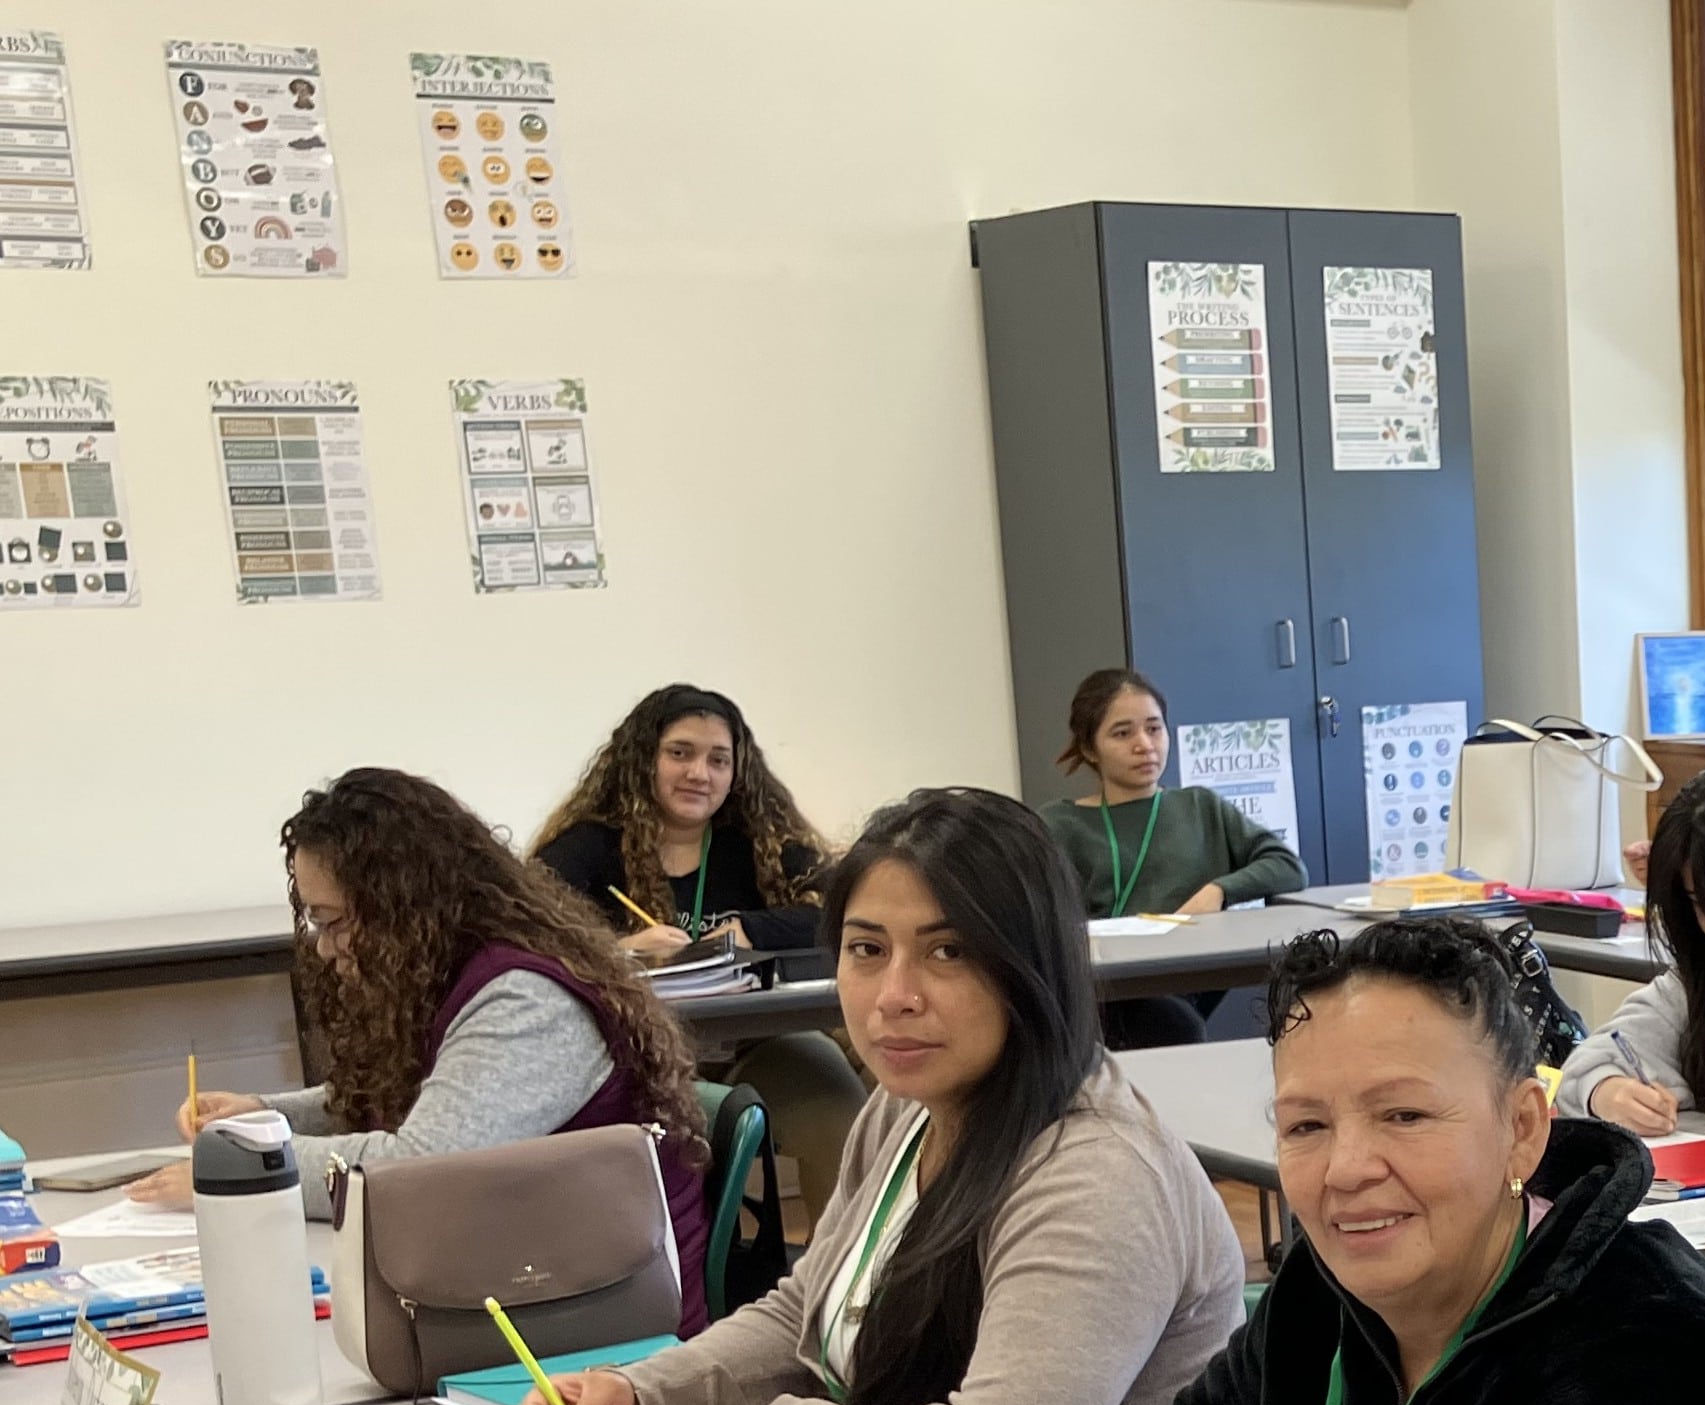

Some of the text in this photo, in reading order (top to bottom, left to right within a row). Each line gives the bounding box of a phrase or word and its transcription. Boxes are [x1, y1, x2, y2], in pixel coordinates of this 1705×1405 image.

[179, 49, 309, 67] CONJUNCTIONS
[421, 79, 549, 97] INTERJECTIONS
[1338, 302, 1420, 317] SENTENCES
[1167, 310, 1250, 327] PROCESS
[231, 388, 339, 405] PRONOUNS
[486, 394, 553, 411] VERBS
[1374, 723, 1456, 739] PUNCTUATION
[1191, 752, 1281, 775] ARTICLES
